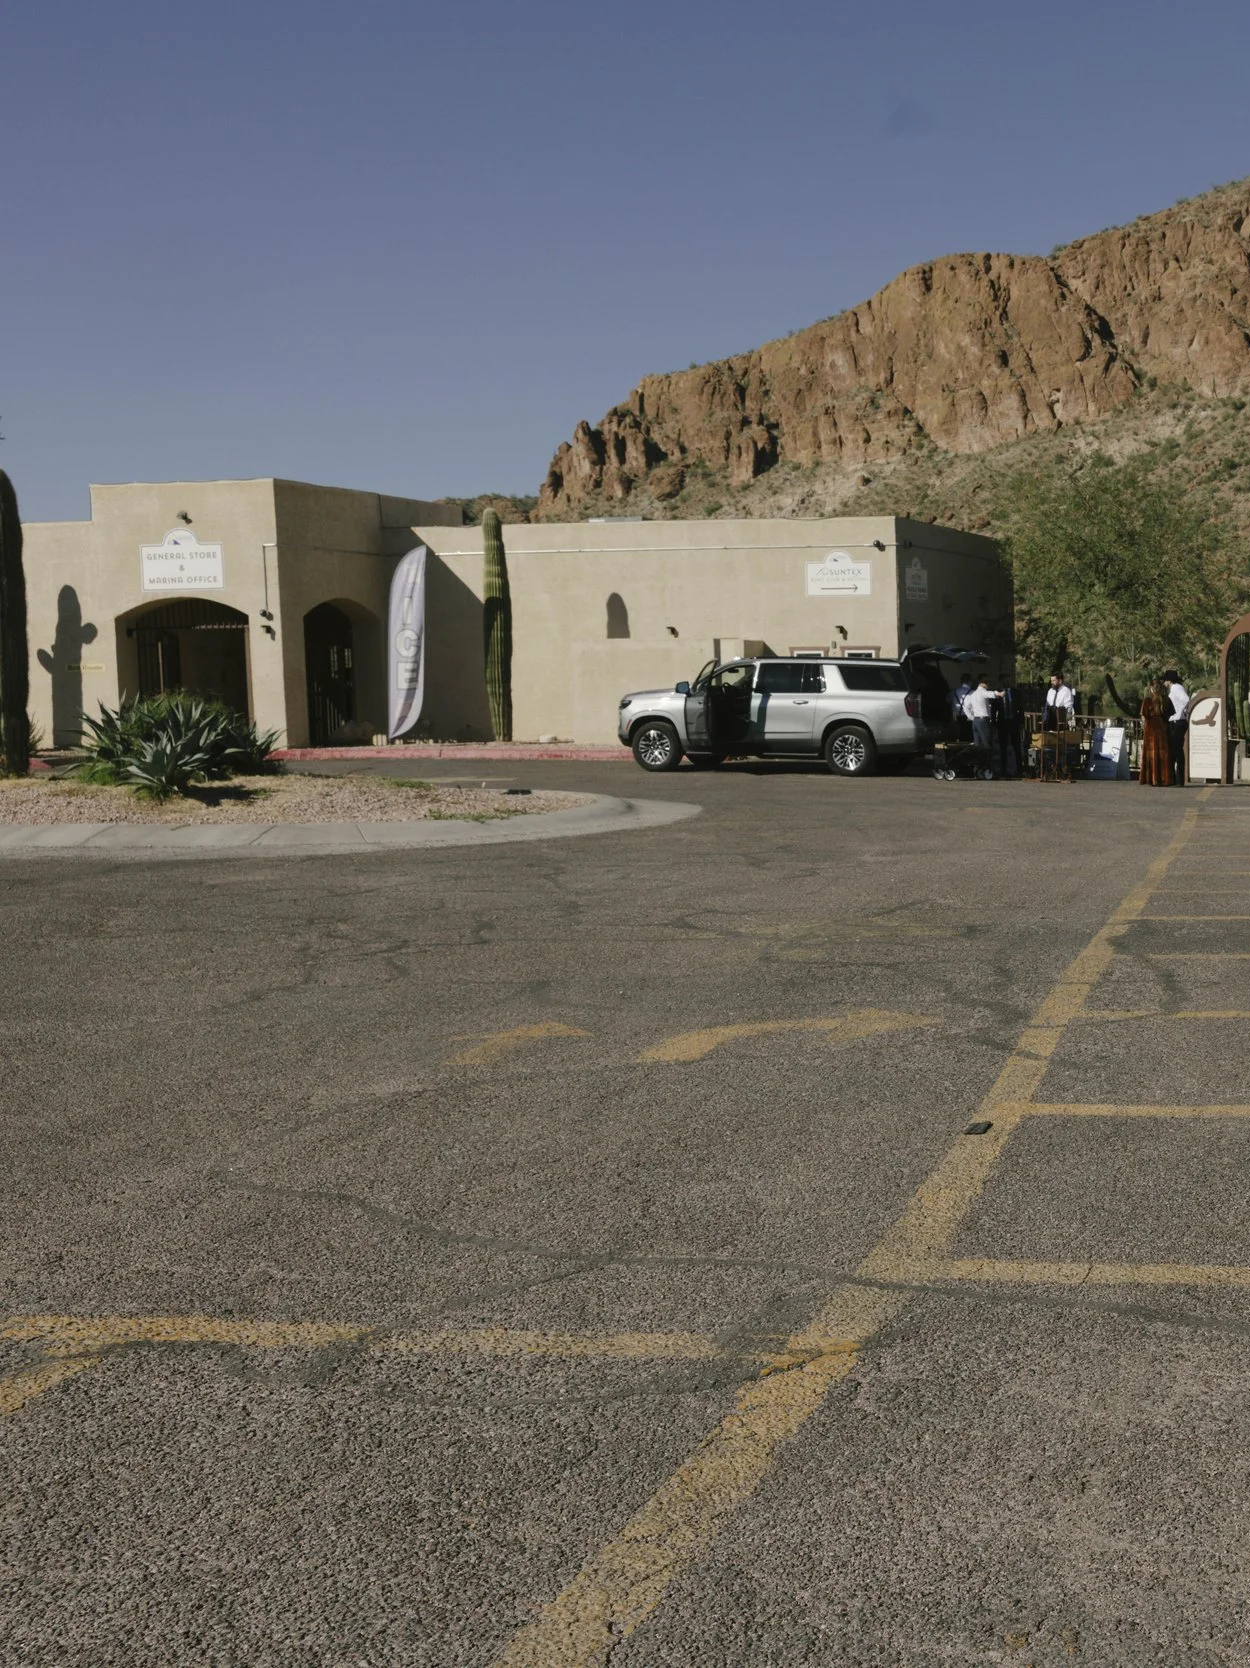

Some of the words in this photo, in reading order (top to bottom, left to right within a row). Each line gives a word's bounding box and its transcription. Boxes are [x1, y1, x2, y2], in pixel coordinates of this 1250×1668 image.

[146, 552, 186, 561] GENERAL
[189, 551, 217, 559] STORE
[179, 564, 185, 572] &
[829, 568, 862, 576] SUNTEX
[148, 576, 184, 585] MARINA
[186, 575, 218, 584] OFFICE
